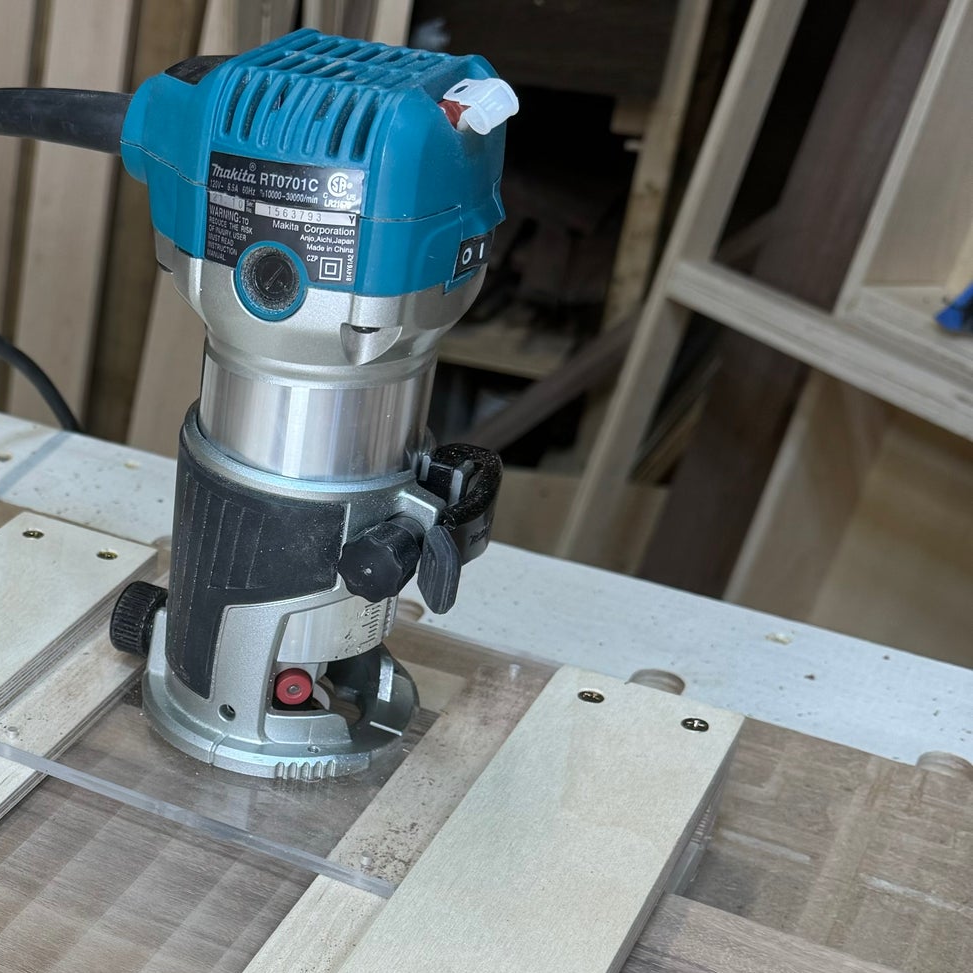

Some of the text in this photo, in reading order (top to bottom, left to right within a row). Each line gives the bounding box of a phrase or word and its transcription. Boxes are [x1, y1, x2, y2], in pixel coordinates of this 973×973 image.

[212, 163, 256, 184] makita
[259, 172, 319, 192] RT0701C
[267, 205, 323, 223] 1563793
[348, 215, 356, 225] Y
[272, 219, 356, 237] Makita Corporation
[306, 243, 354, 254] Made in China
